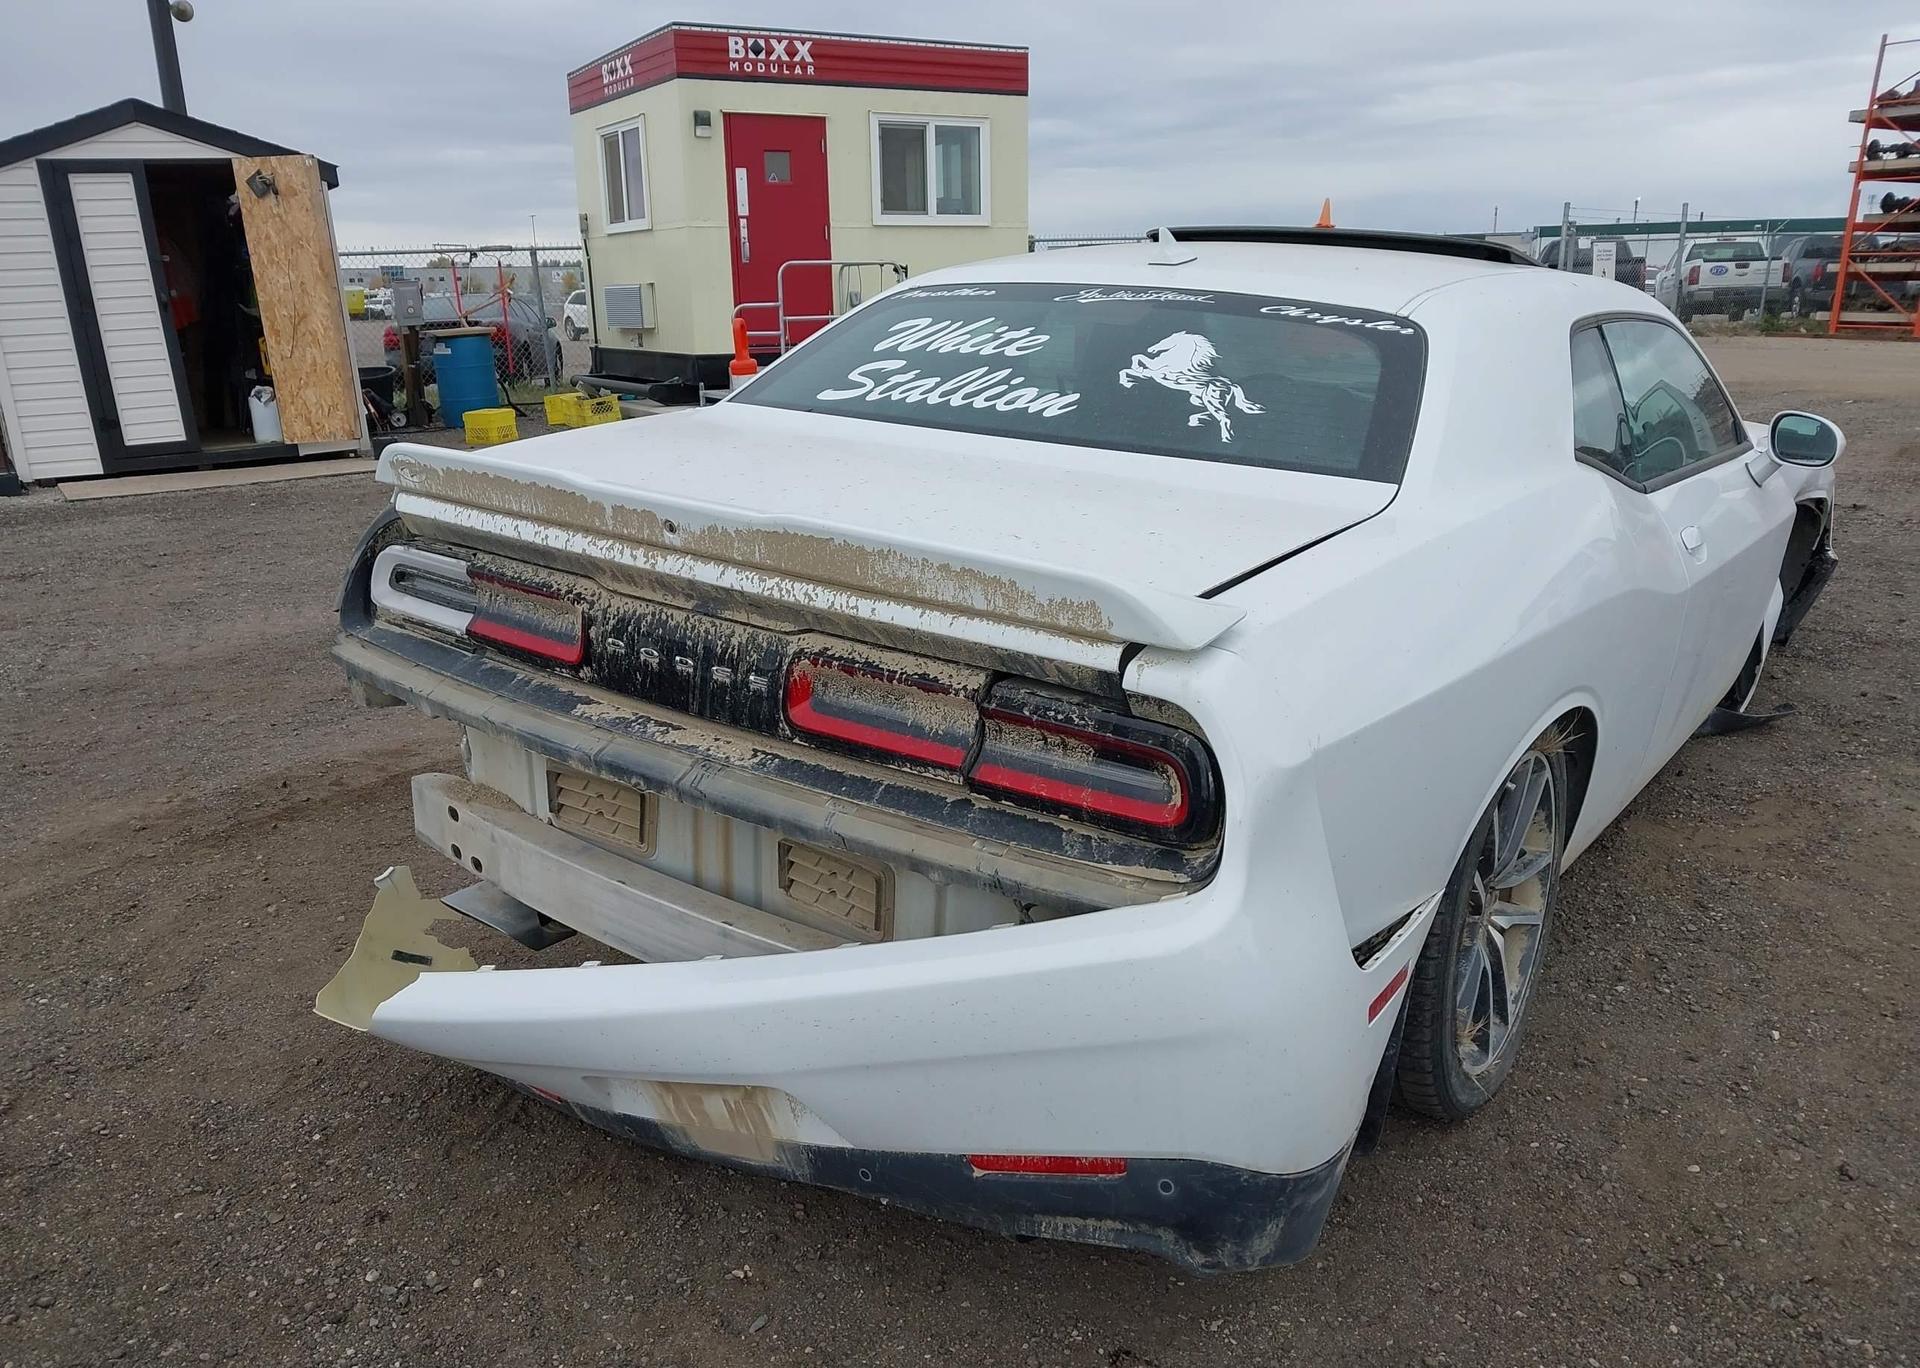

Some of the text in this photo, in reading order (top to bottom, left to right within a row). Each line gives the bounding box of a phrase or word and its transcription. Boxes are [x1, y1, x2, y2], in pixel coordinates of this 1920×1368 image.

[728, 35, 814, 62] BOXX
[602, 53, 632, 84] BOXX
[729, 61, 815, 75] MODULAR
[603, 77, 634, 97] MODULAR
[888, 286, 997, 300] Another
[1259, 305, 1415, 335] Chrysler
[873, 317, 1050, 356] White
[816, 359, 1081, 417] Stallion
[606, 637, 769, 692] DODGE
